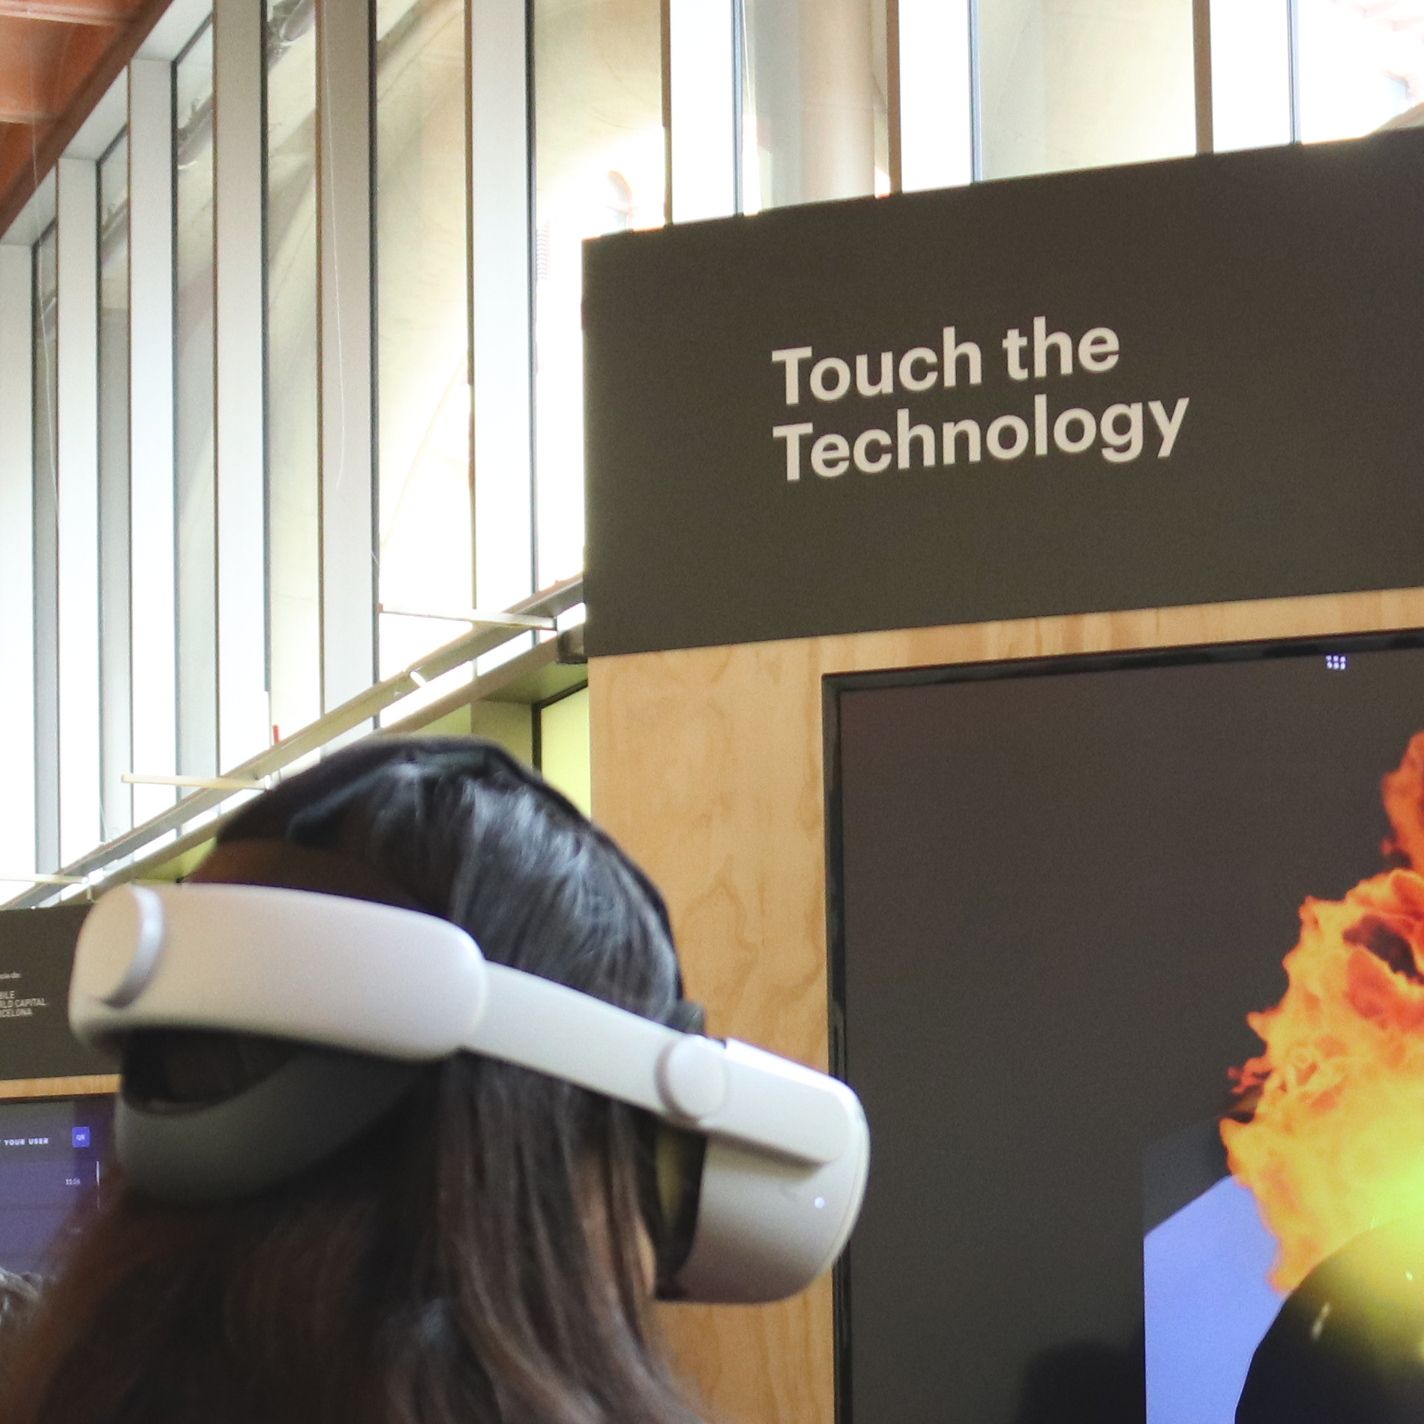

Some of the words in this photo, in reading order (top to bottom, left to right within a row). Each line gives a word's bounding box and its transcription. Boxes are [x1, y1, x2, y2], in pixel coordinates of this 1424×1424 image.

[771, 326, 983, 405] Touch
[1002, 315, 1121, 380] the
[772, 393, 1190, 482] Technology
[4, 1138, 25, 1146] YOUR
